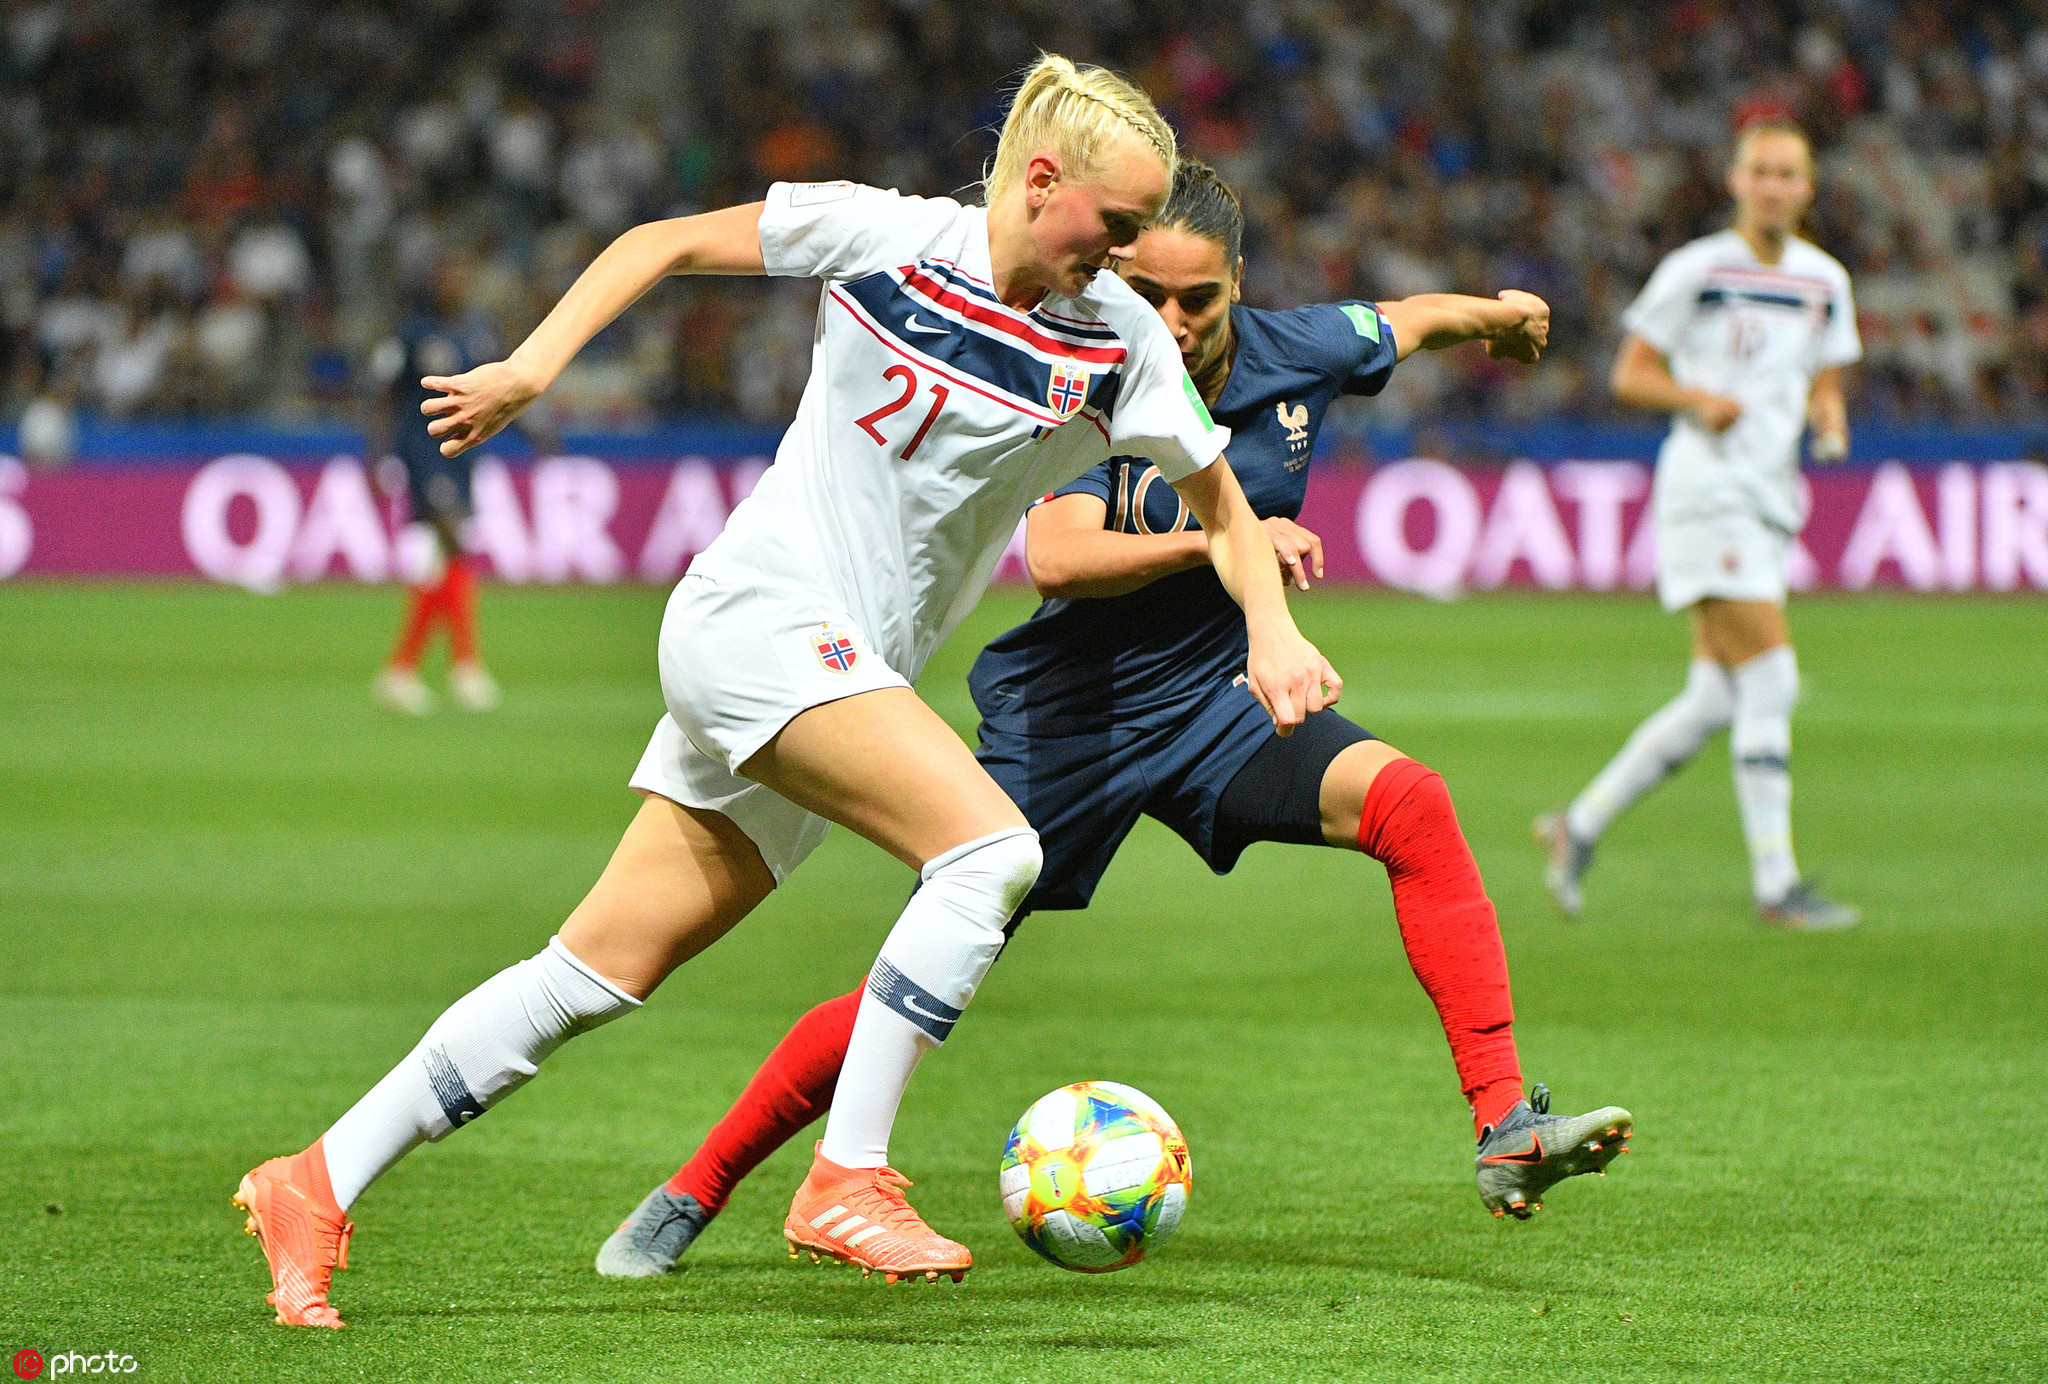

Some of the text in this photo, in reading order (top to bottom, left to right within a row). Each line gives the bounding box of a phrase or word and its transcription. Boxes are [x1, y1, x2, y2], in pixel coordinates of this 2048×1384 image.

[854, 365, 949, 462] 21
[181, 454, 628, 594] QAAR
[1113, 463, 1190, 535] 10
